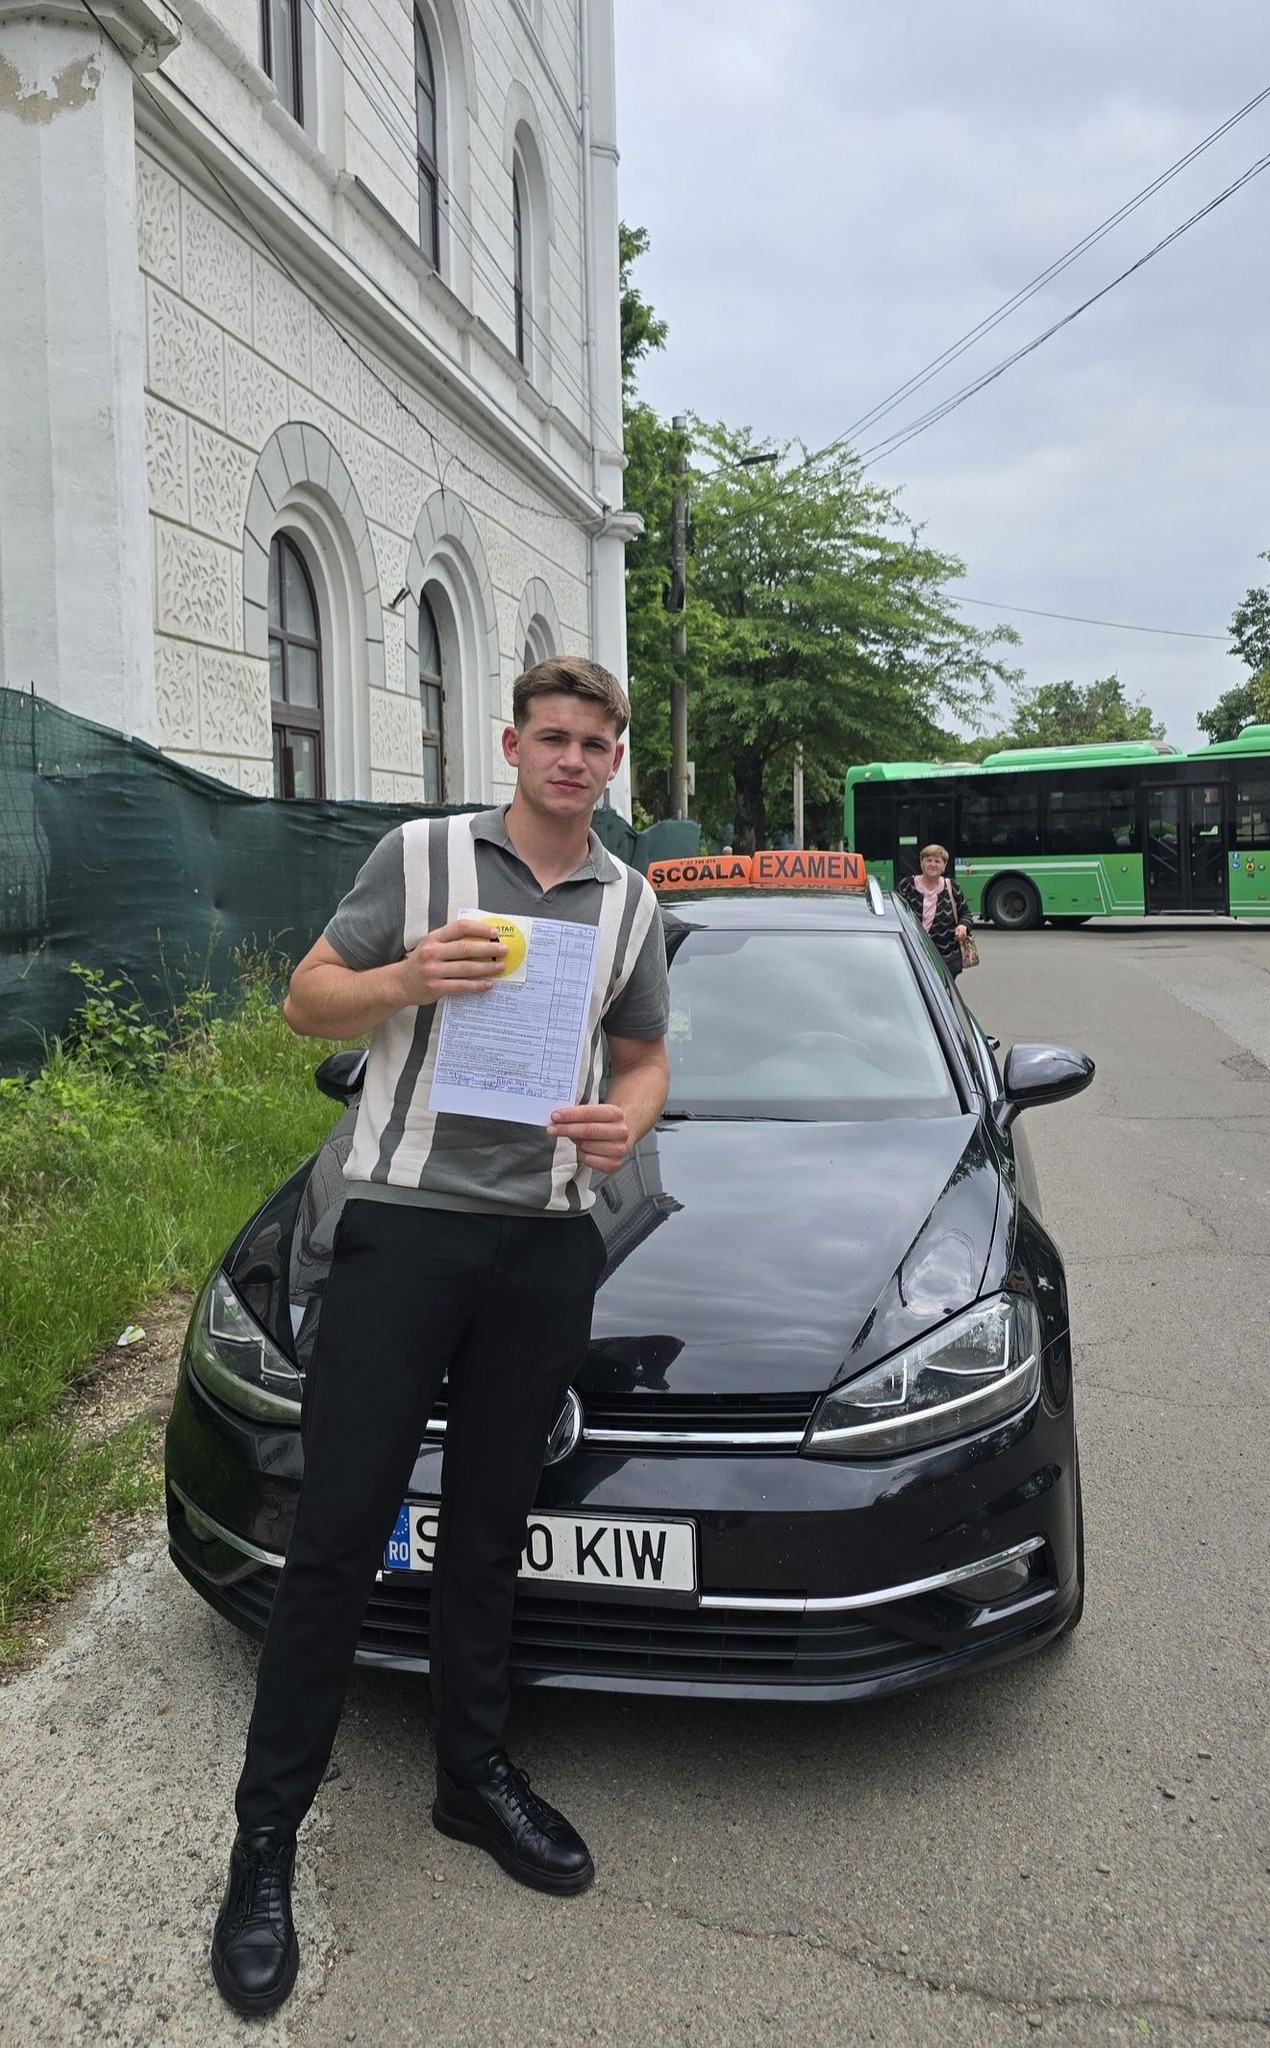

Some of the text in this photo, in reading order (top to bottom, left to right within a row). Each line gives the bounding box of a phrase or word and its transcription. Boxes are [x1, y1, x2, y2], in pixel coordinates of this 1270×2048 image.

[760, 855, 858, 879] EXAMEN
[389, 1541, 408, 1562] RO
[416, 1515, 667, 1581] S 0 KIW
